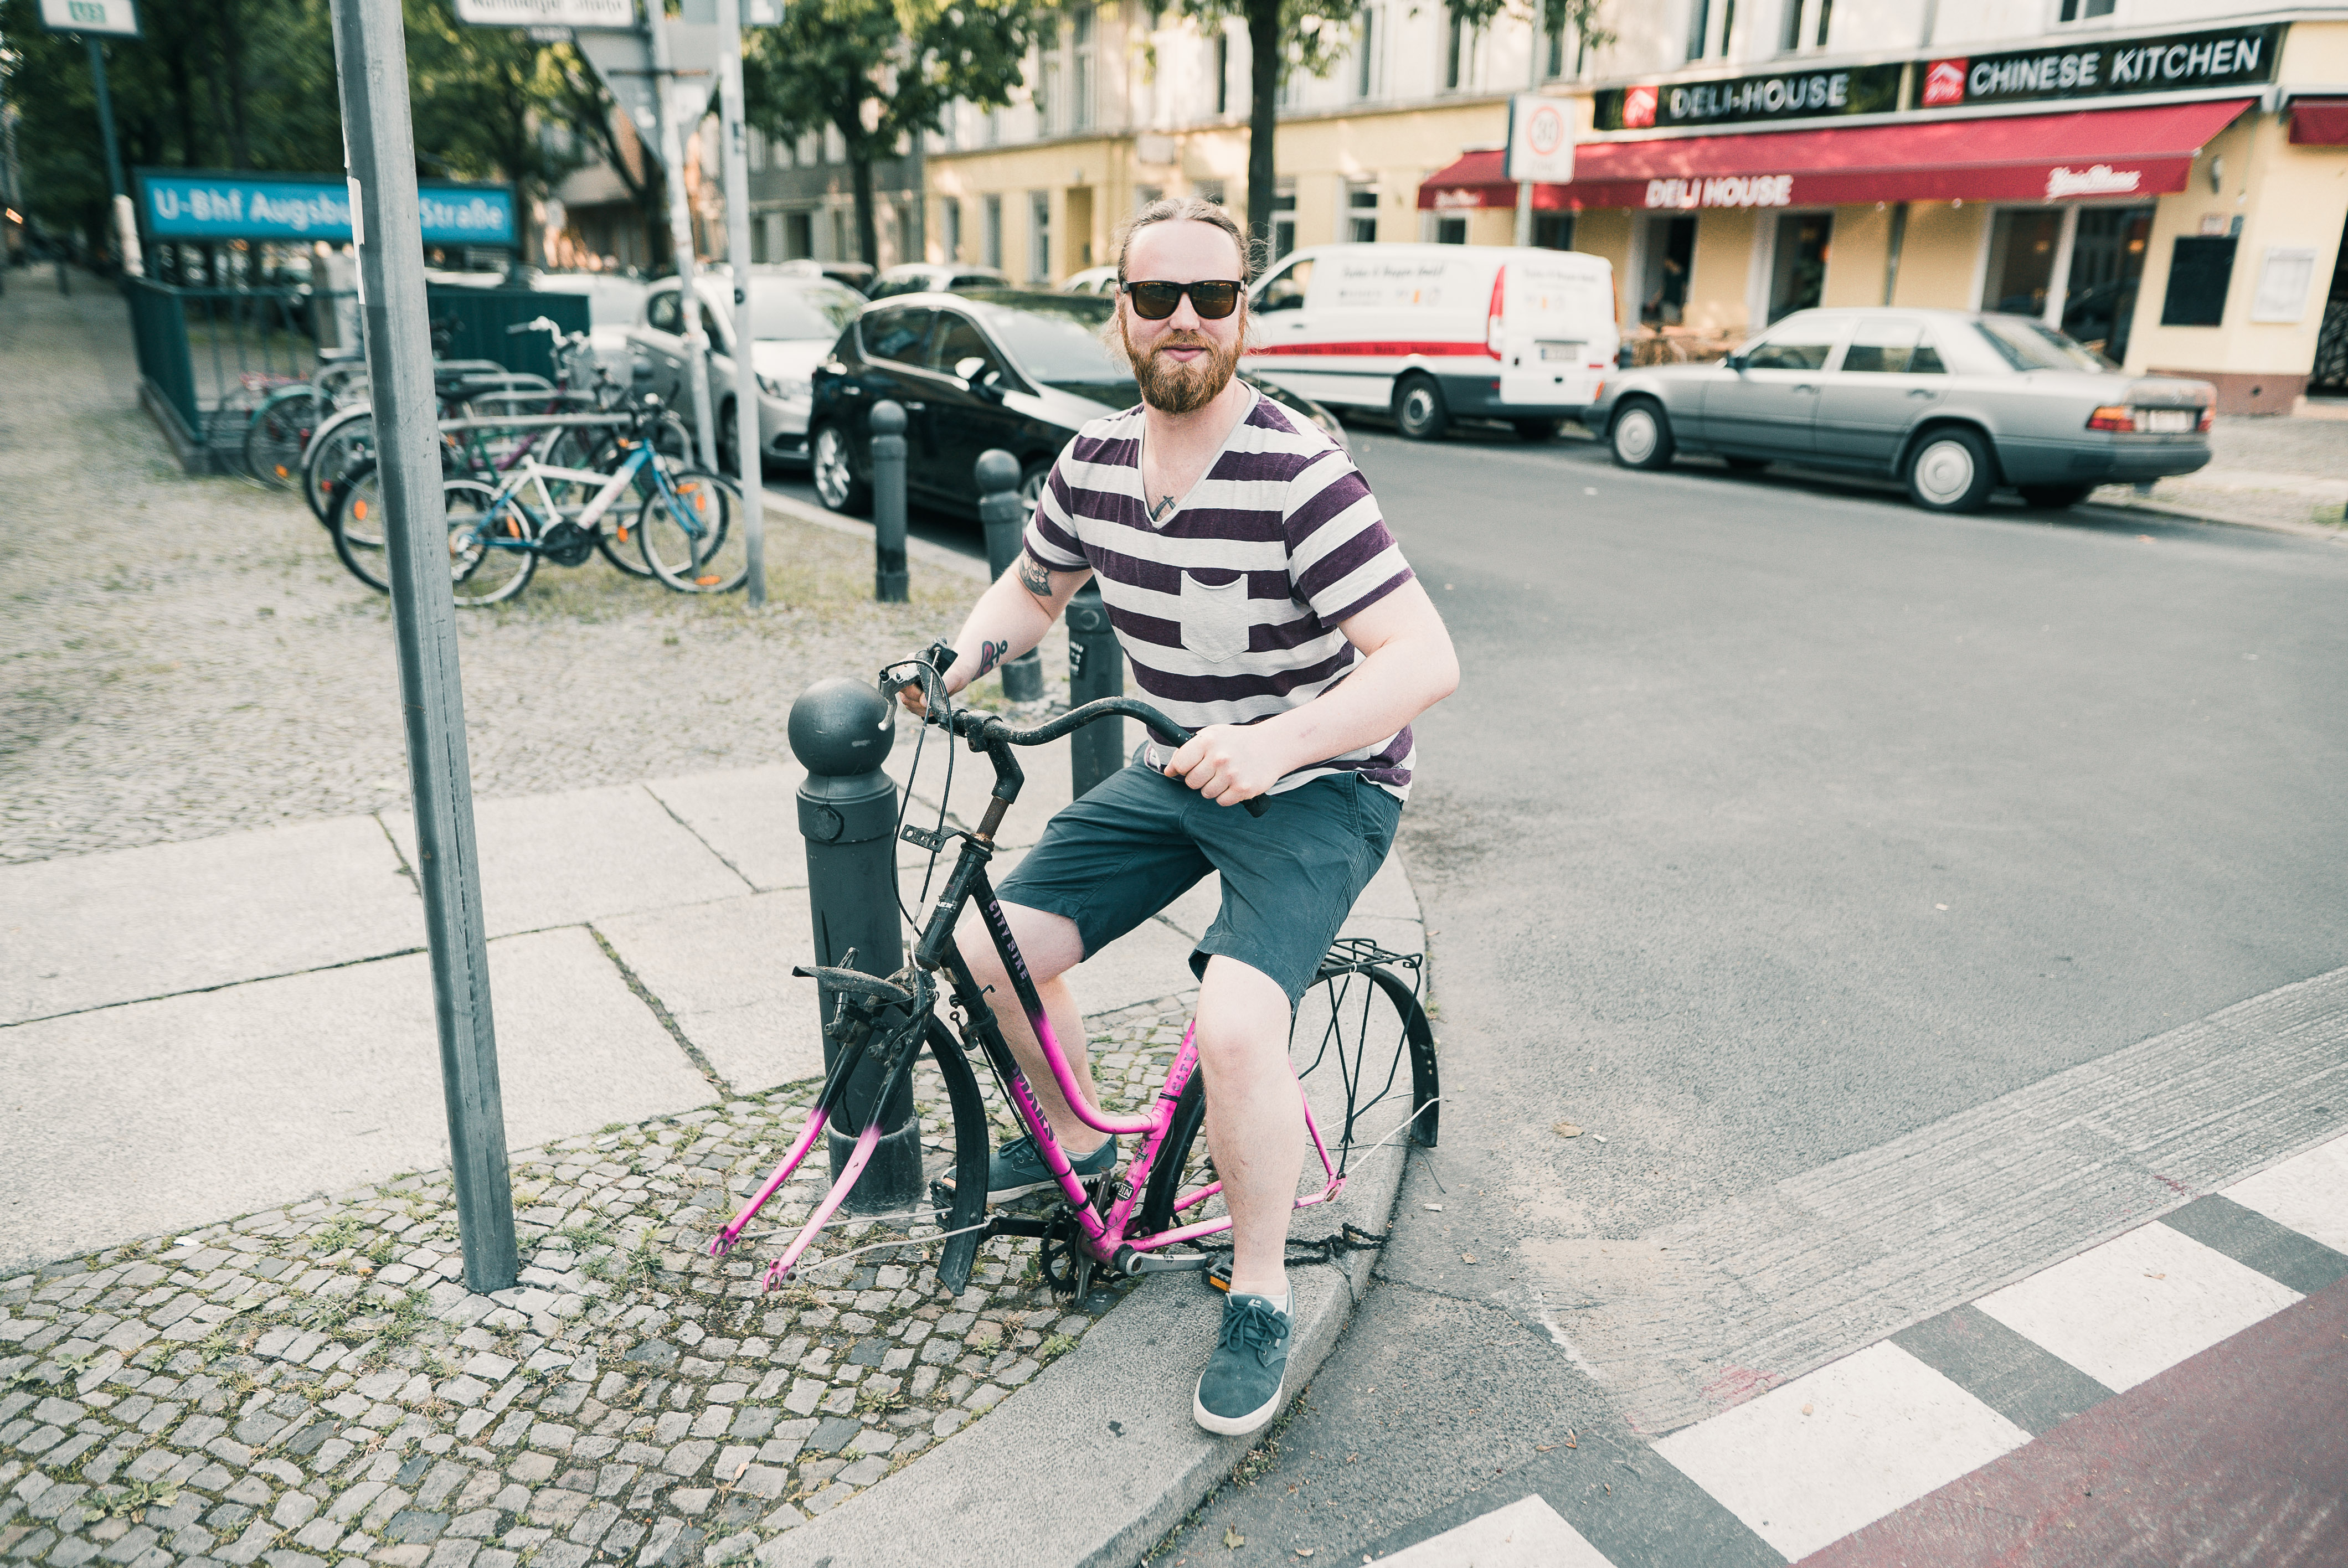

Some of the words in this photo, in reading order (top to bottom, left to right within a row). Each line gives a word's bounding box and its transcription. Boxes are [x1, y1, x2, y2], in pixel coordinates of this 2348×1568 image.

[1969, 51, 2102, 96] CHINESE
[2109, 37, 2261, 85] KITCHEN
[1669, 73, 1850, 119] DELI-HOUSE
[153, 187, 243, 222] U-Bhf
[249, 191, 350, 231] Augsbu
[419, 197, 503, 230] Straße
[1645, 178, 1702, 208] DELI
[1702, 174, 1794, 207] HOUSE
[988, 900, 1011, 937] CITY
[1007, 938, 1028, 979] BIKE
[1171, 1052, 1194, 1091] CITY
